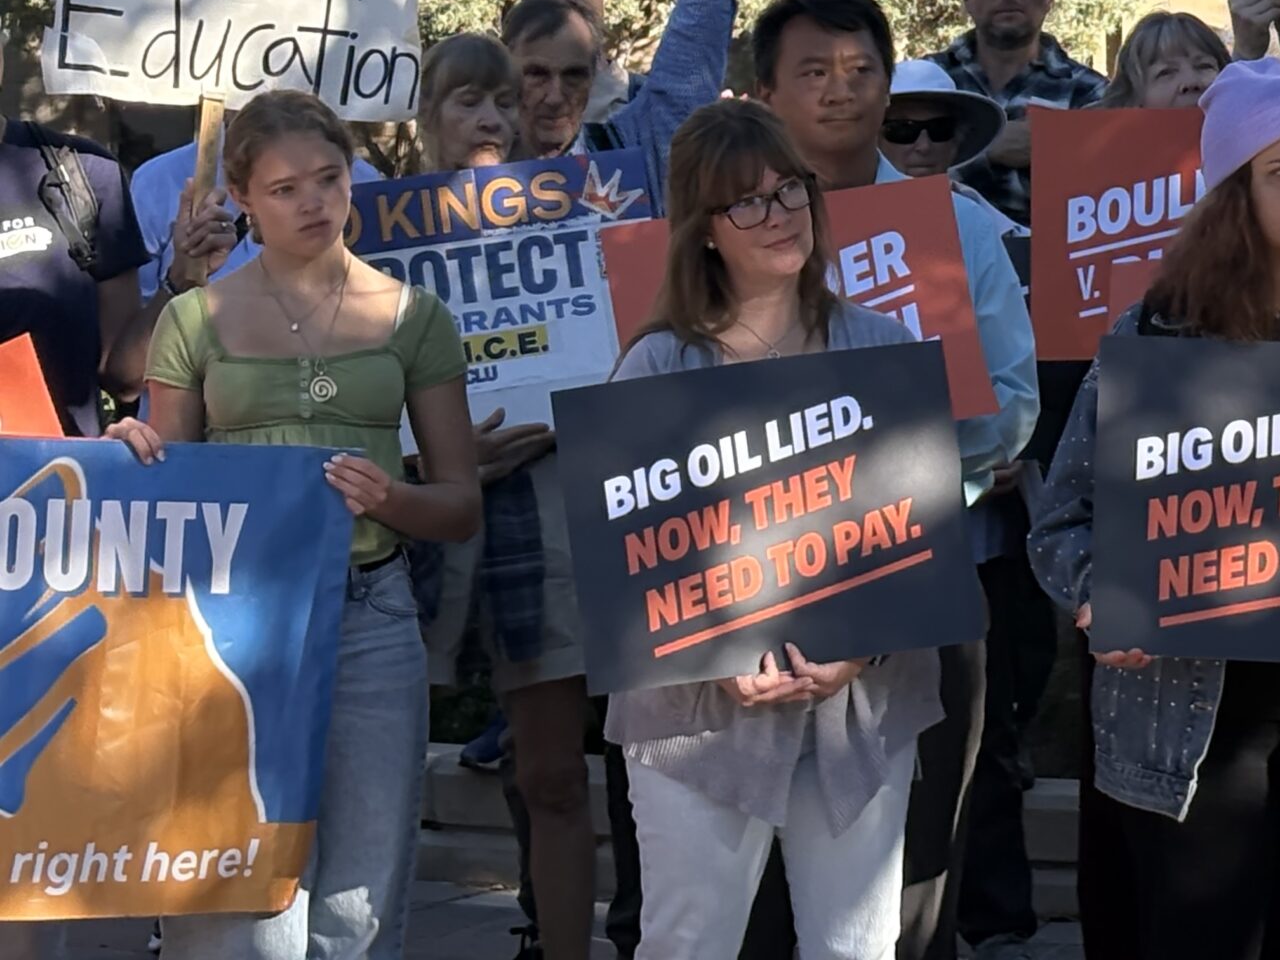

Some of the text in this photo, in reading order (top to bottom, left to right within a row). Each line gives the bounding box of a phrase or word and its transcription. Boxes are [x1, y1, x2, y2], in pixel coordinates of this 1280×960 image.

[377, 172, 572, 242] KINGS
[1067, 169, 1206, 244] BOUL
[1077, 265, 1099, 300] V.
[453, 294, 597, 335] RANTS
[463, 331, 549, 363] I.C.E.
[604, 395, 873, 520] BIG OIL LIED.
[1136, 427, 1213, 480] BIG
[624, 455, 856, 575] NOW, THEY
[1147, 481, 1264, 541] NOW,
[646, 497, 922, 632] NEED TO PAY.
[1159, 540, 1279, 601] NEED
[10, 838, 260, 896] right here!
